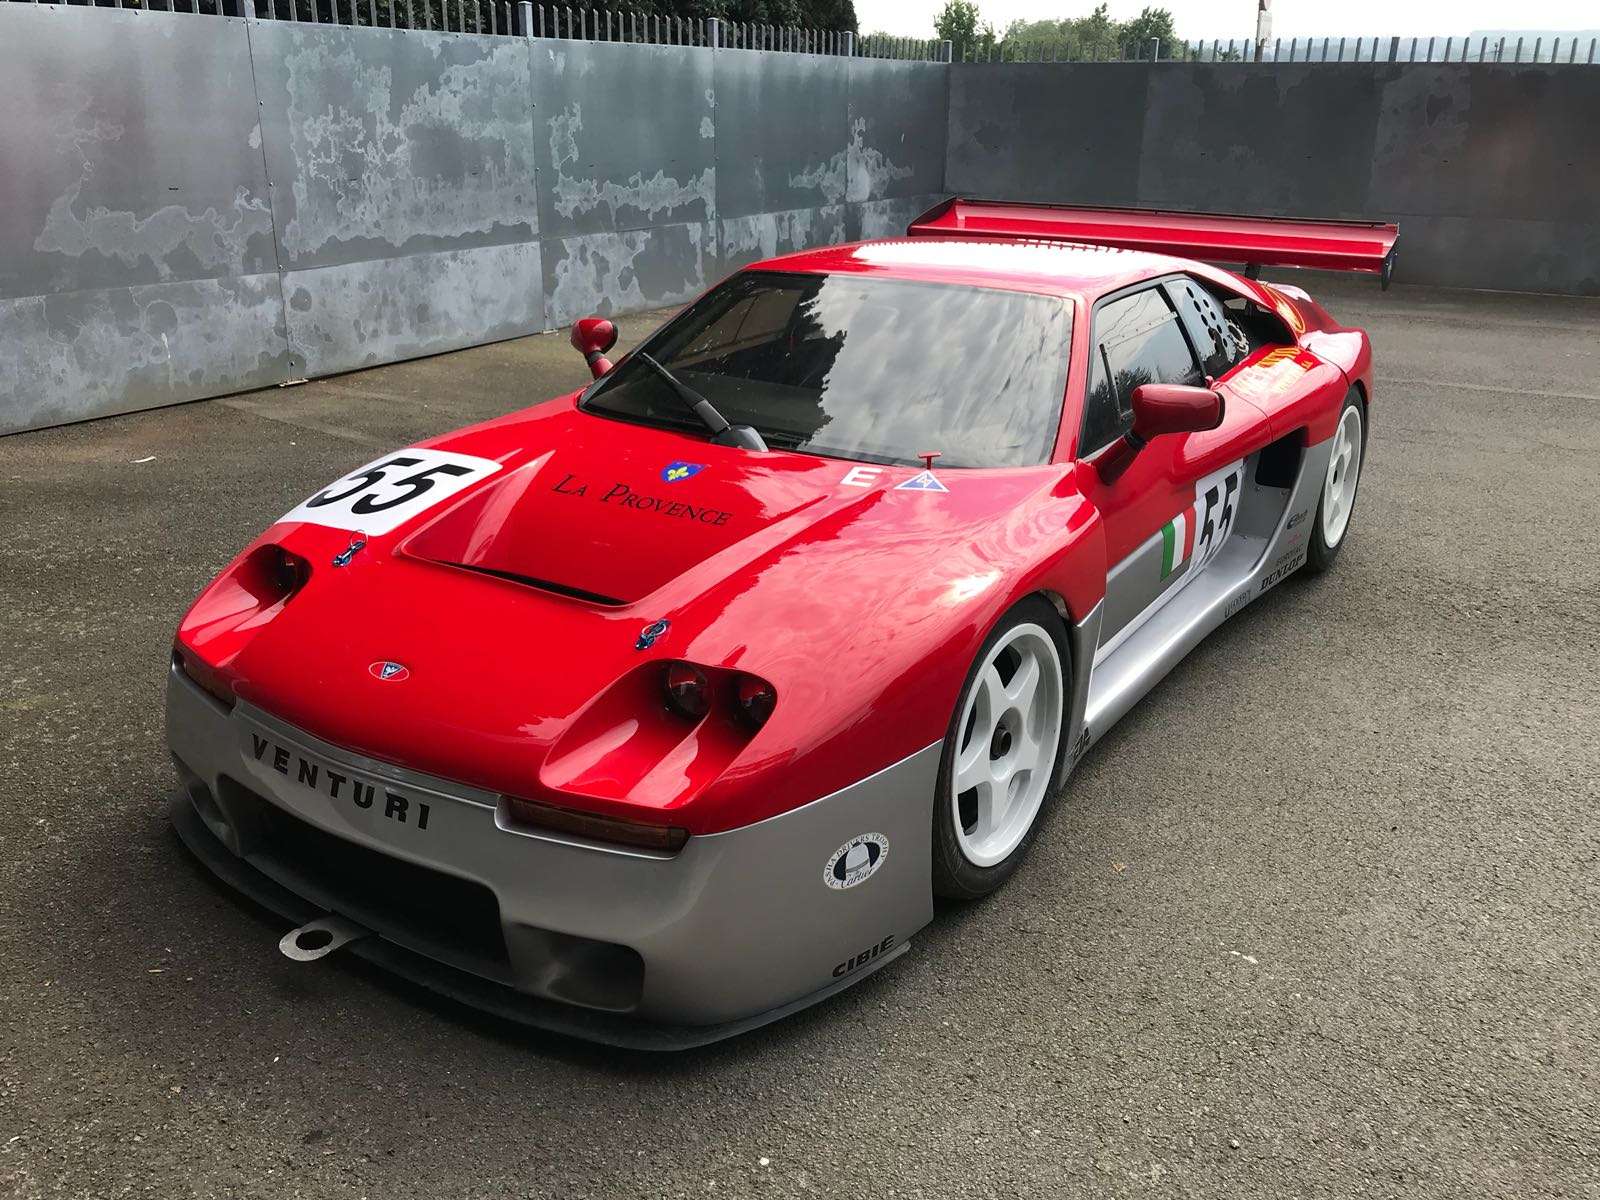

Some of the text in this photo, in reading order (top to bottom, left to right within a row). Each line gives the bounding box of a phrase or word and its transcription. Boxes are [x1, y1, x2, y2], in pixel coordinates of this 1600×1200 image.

[305, 457, 475, 515] 55
[839, 466, 884, 488] E
[1192, 471, 1238, 572] 55
[1259, 552, 1304, 592] DUNLOP
[252, 733, 430, 830] VENTURI
[832, 934, 895, 978] CIBIE
